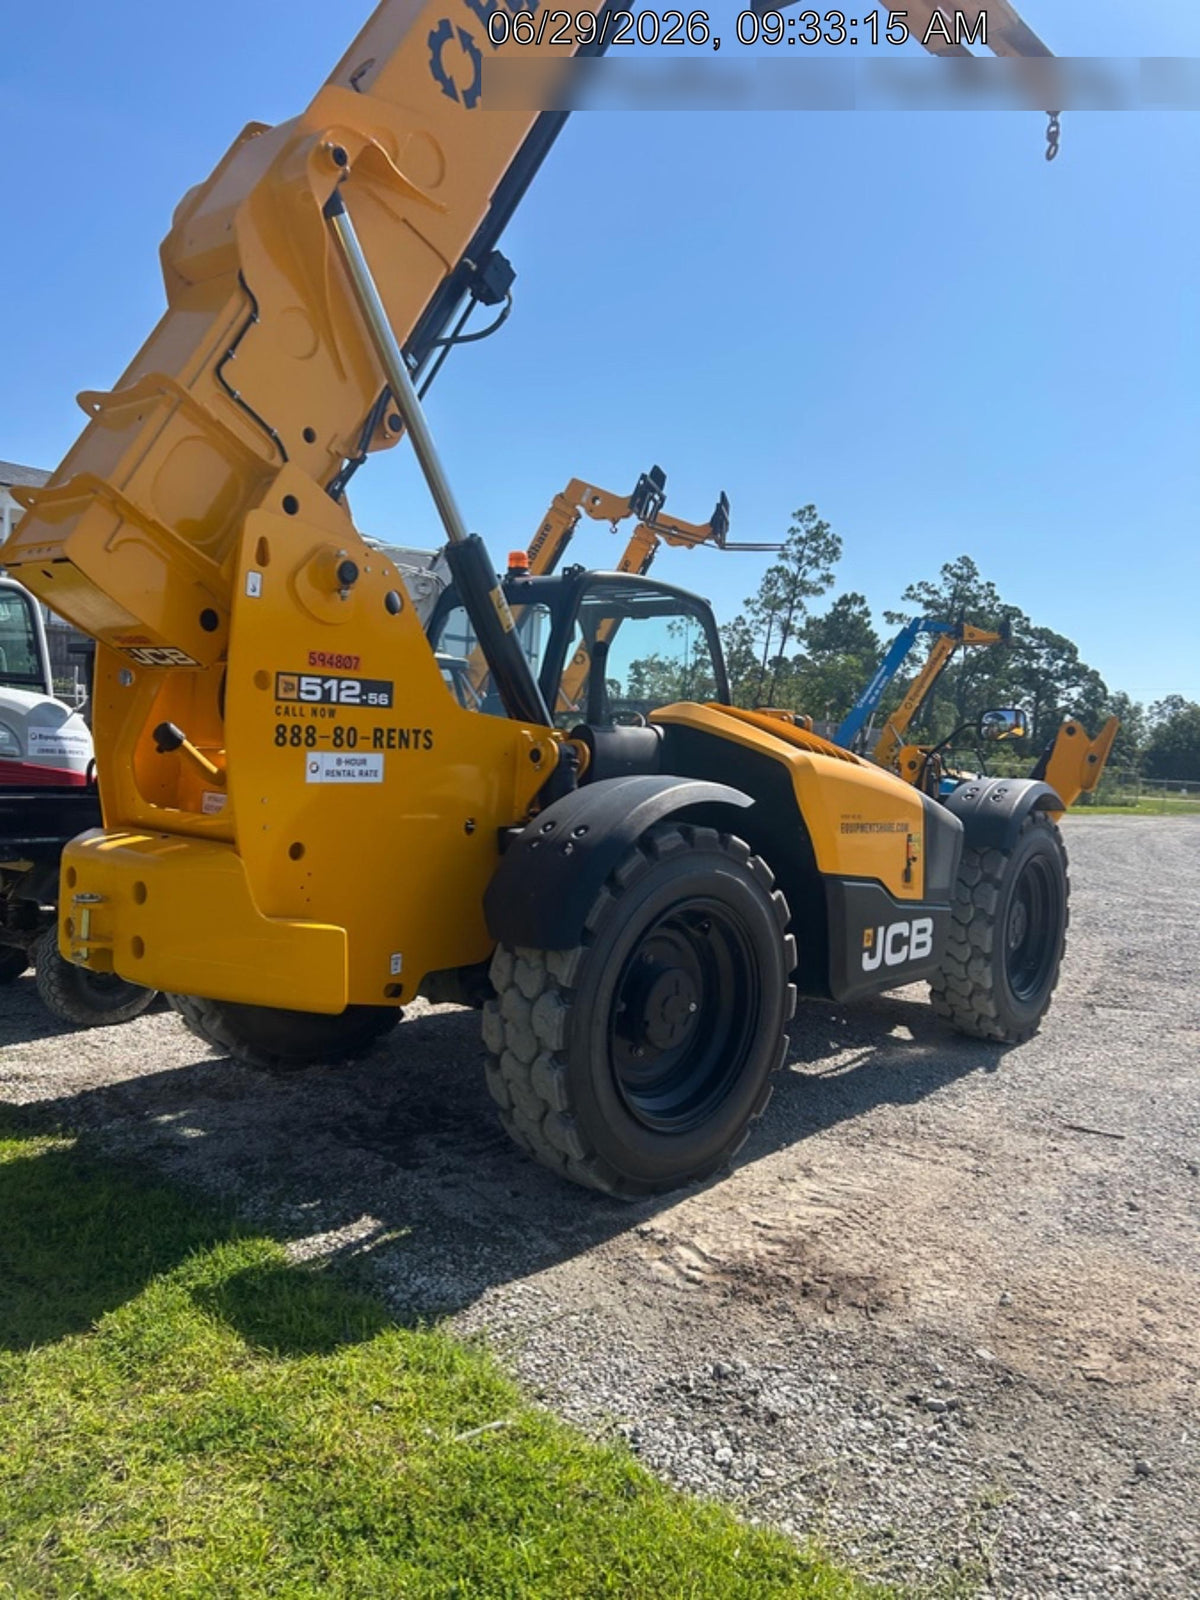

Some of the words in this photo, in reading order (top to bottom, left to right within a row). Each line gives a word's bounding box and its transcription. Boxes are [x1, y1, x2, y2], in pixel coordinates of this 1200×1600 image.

[129, 648, 198, 665] JCB
[308, 651, 361, 670] 594807
[275, 705, 305, 718] CALL
[311, 707, 337, 719] NOW
[274, 723, 434, 750] 888-80-RENTS
[325, 769, 356, 778] RENTAL
[358, 769, 379, 778] RATE
[862, 917, 934, 971] JCB
